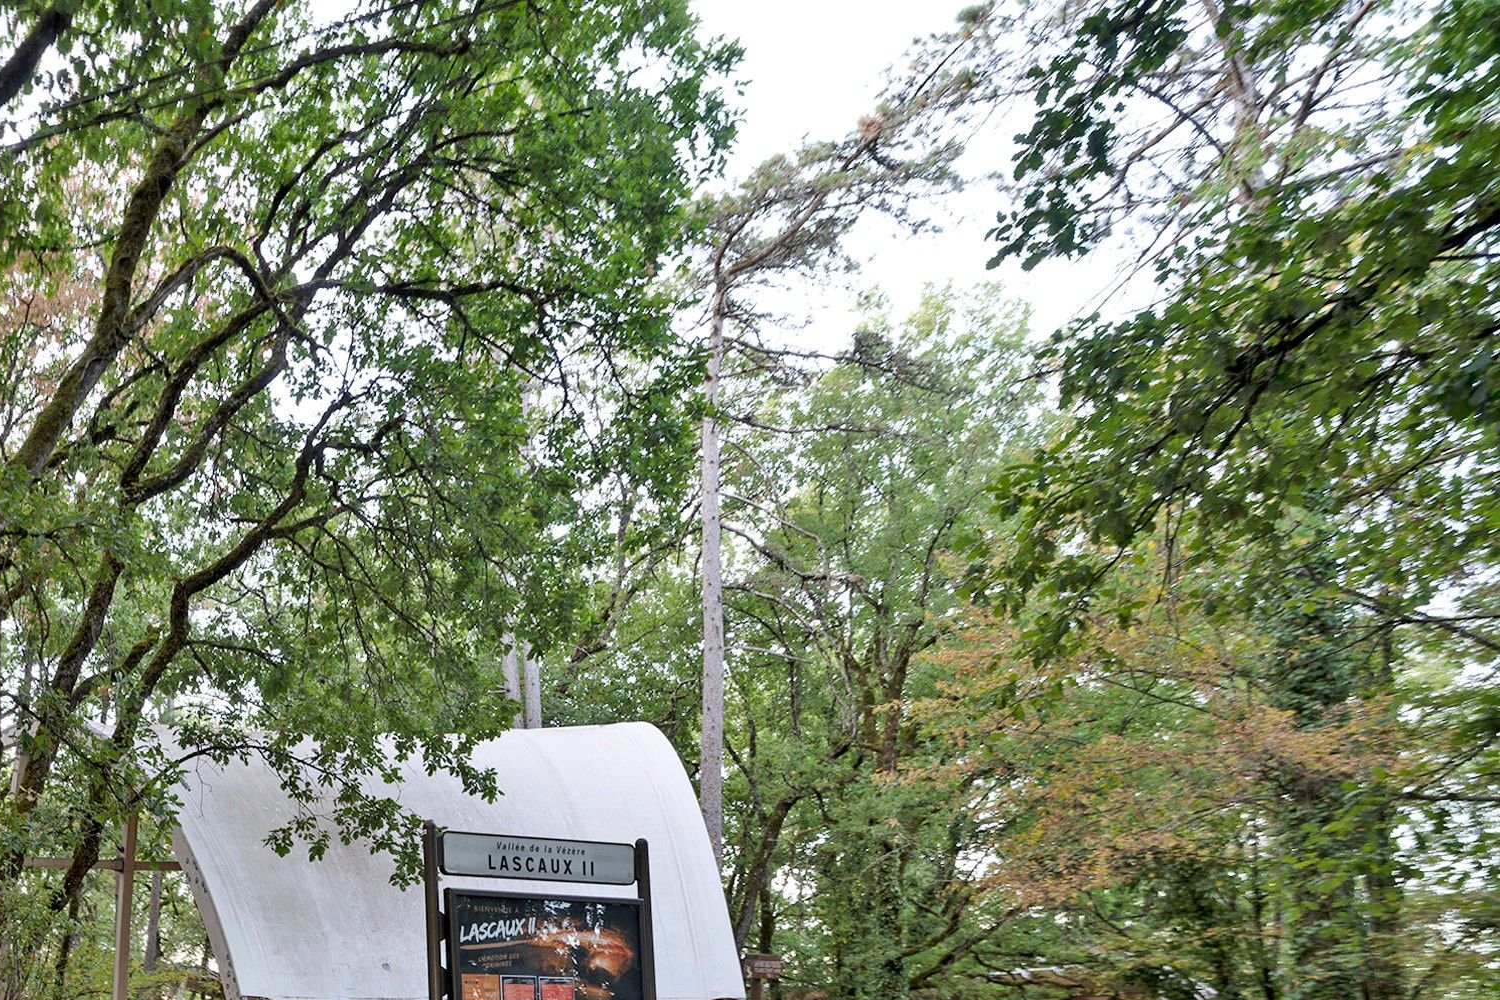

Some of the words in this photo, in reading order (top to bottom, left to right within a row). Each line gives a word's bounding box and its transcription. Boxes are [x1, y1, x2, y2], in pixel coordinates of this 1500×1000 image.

[496, 841, 525, 851] Vallée
[529, 844, 540, 853] de
[544, 845, 552, 853] la
[556, 845, 586, 856] Vézère
[488, 854, 573, 875] LASCAUX
[582, 861, 594, 876] II
[459, 918, 526, 943] LASCAUX
[528, 916, 536, 935] II
